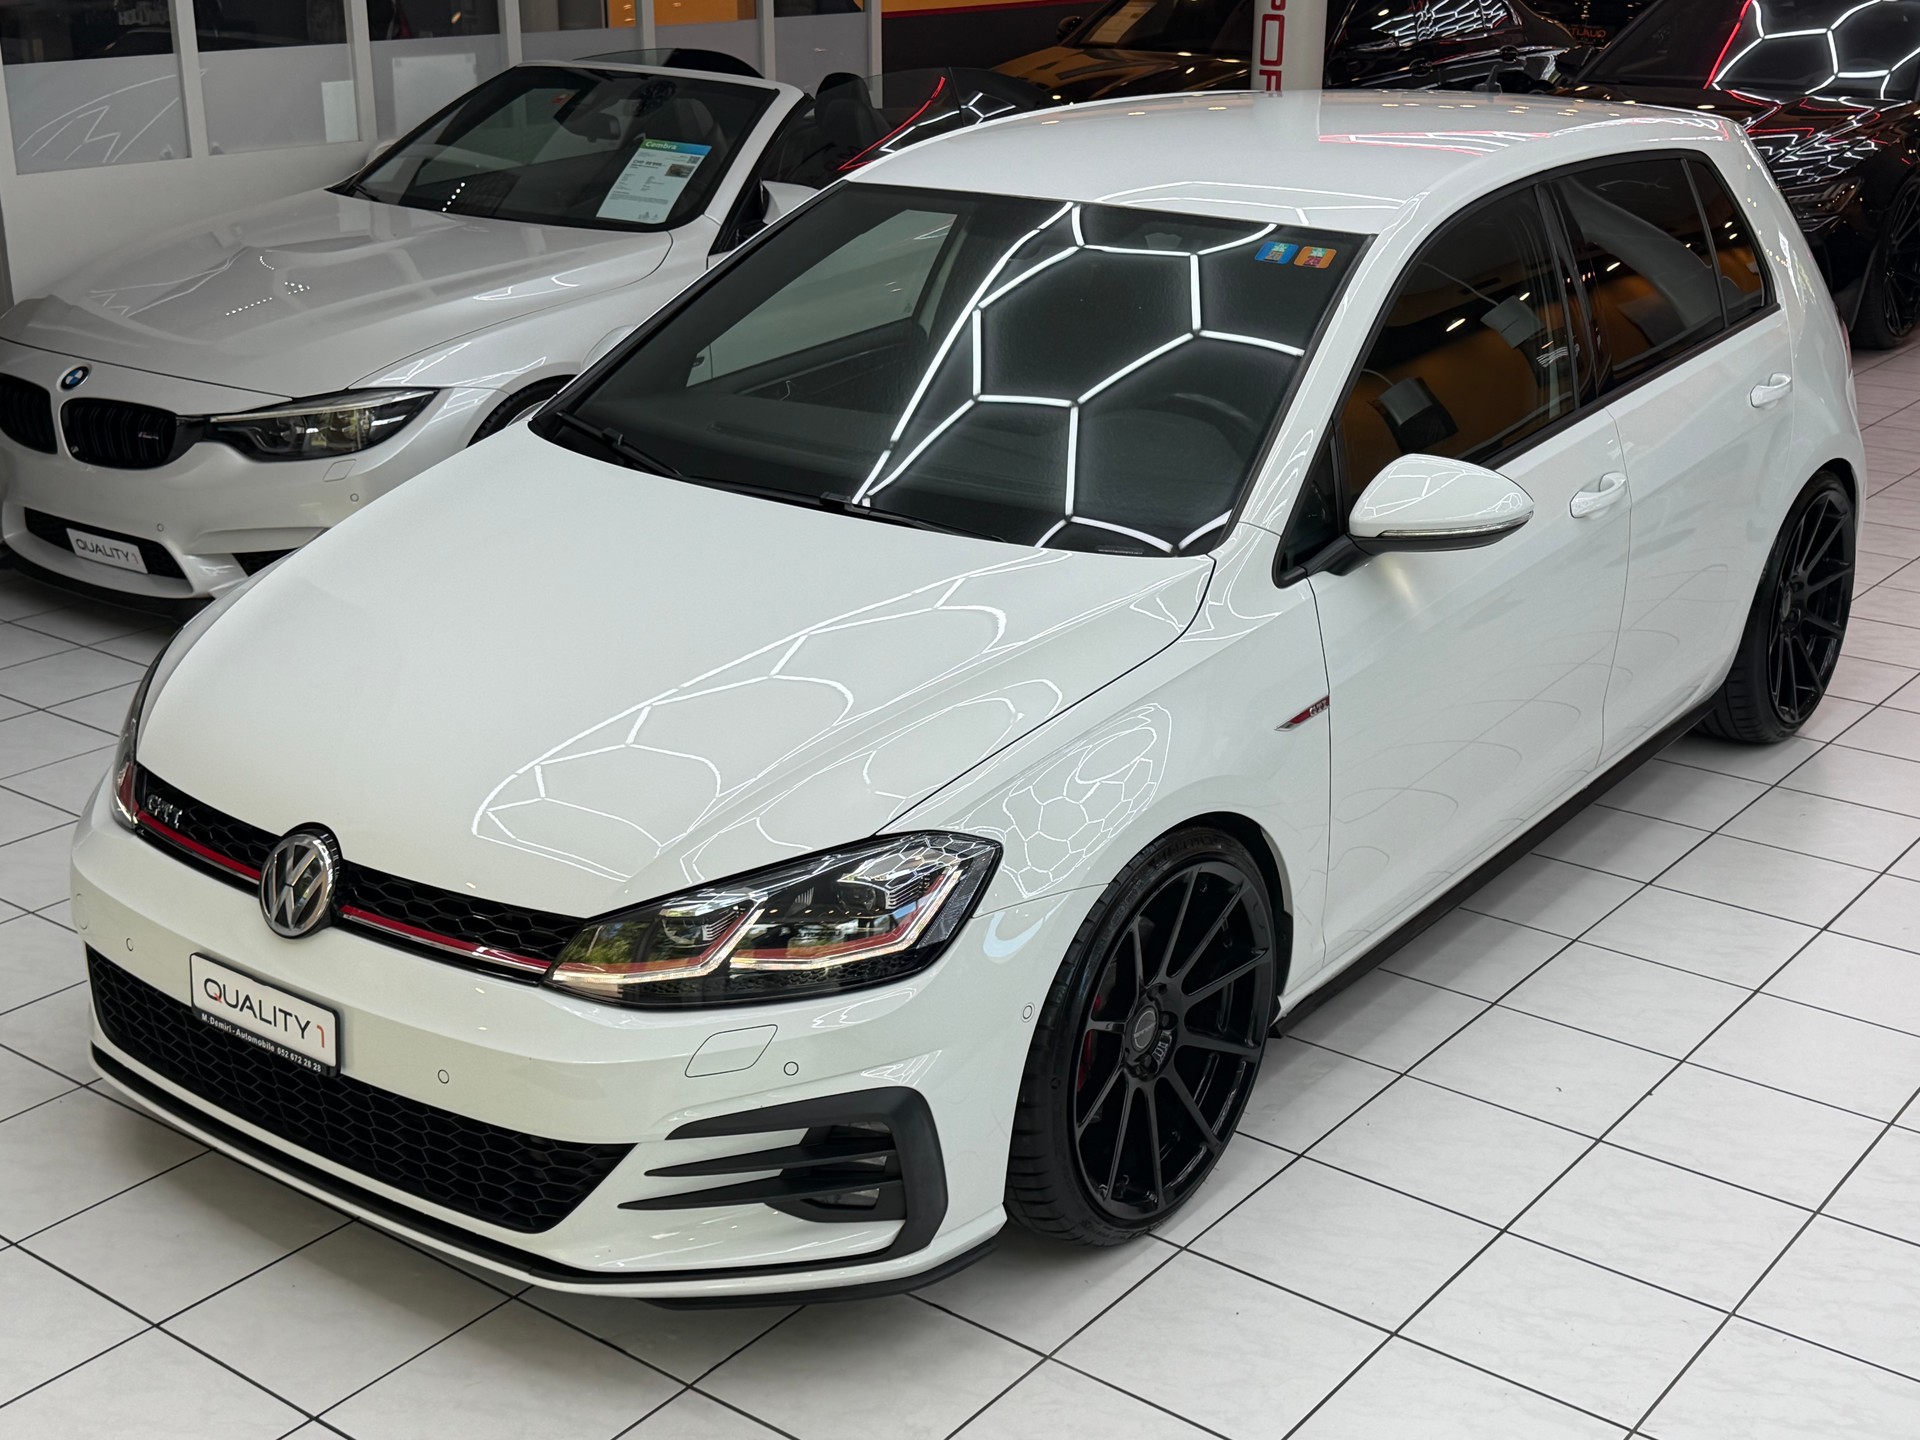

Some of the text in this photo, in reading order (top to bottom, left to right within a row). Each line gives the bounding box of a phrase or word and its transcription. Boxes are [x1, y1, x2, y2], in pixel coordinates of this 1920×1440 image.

[645, 140, 678, 151] Cembra
[75, 538, 130, 562] QUALITY
[1309, 699, 1328, 718] GTI
[146, 794, 183, 829] GTI
[204, 977, 325, 1048] QUALITY 1
[235, 1028, 275, 1052] Automobile
[277, 1047, 289, 1059] 052
[290, 1053, 302, 1064] 672
[303, 1058, 312, 1069] 28
[313, 1062, 322, 1073] 28
